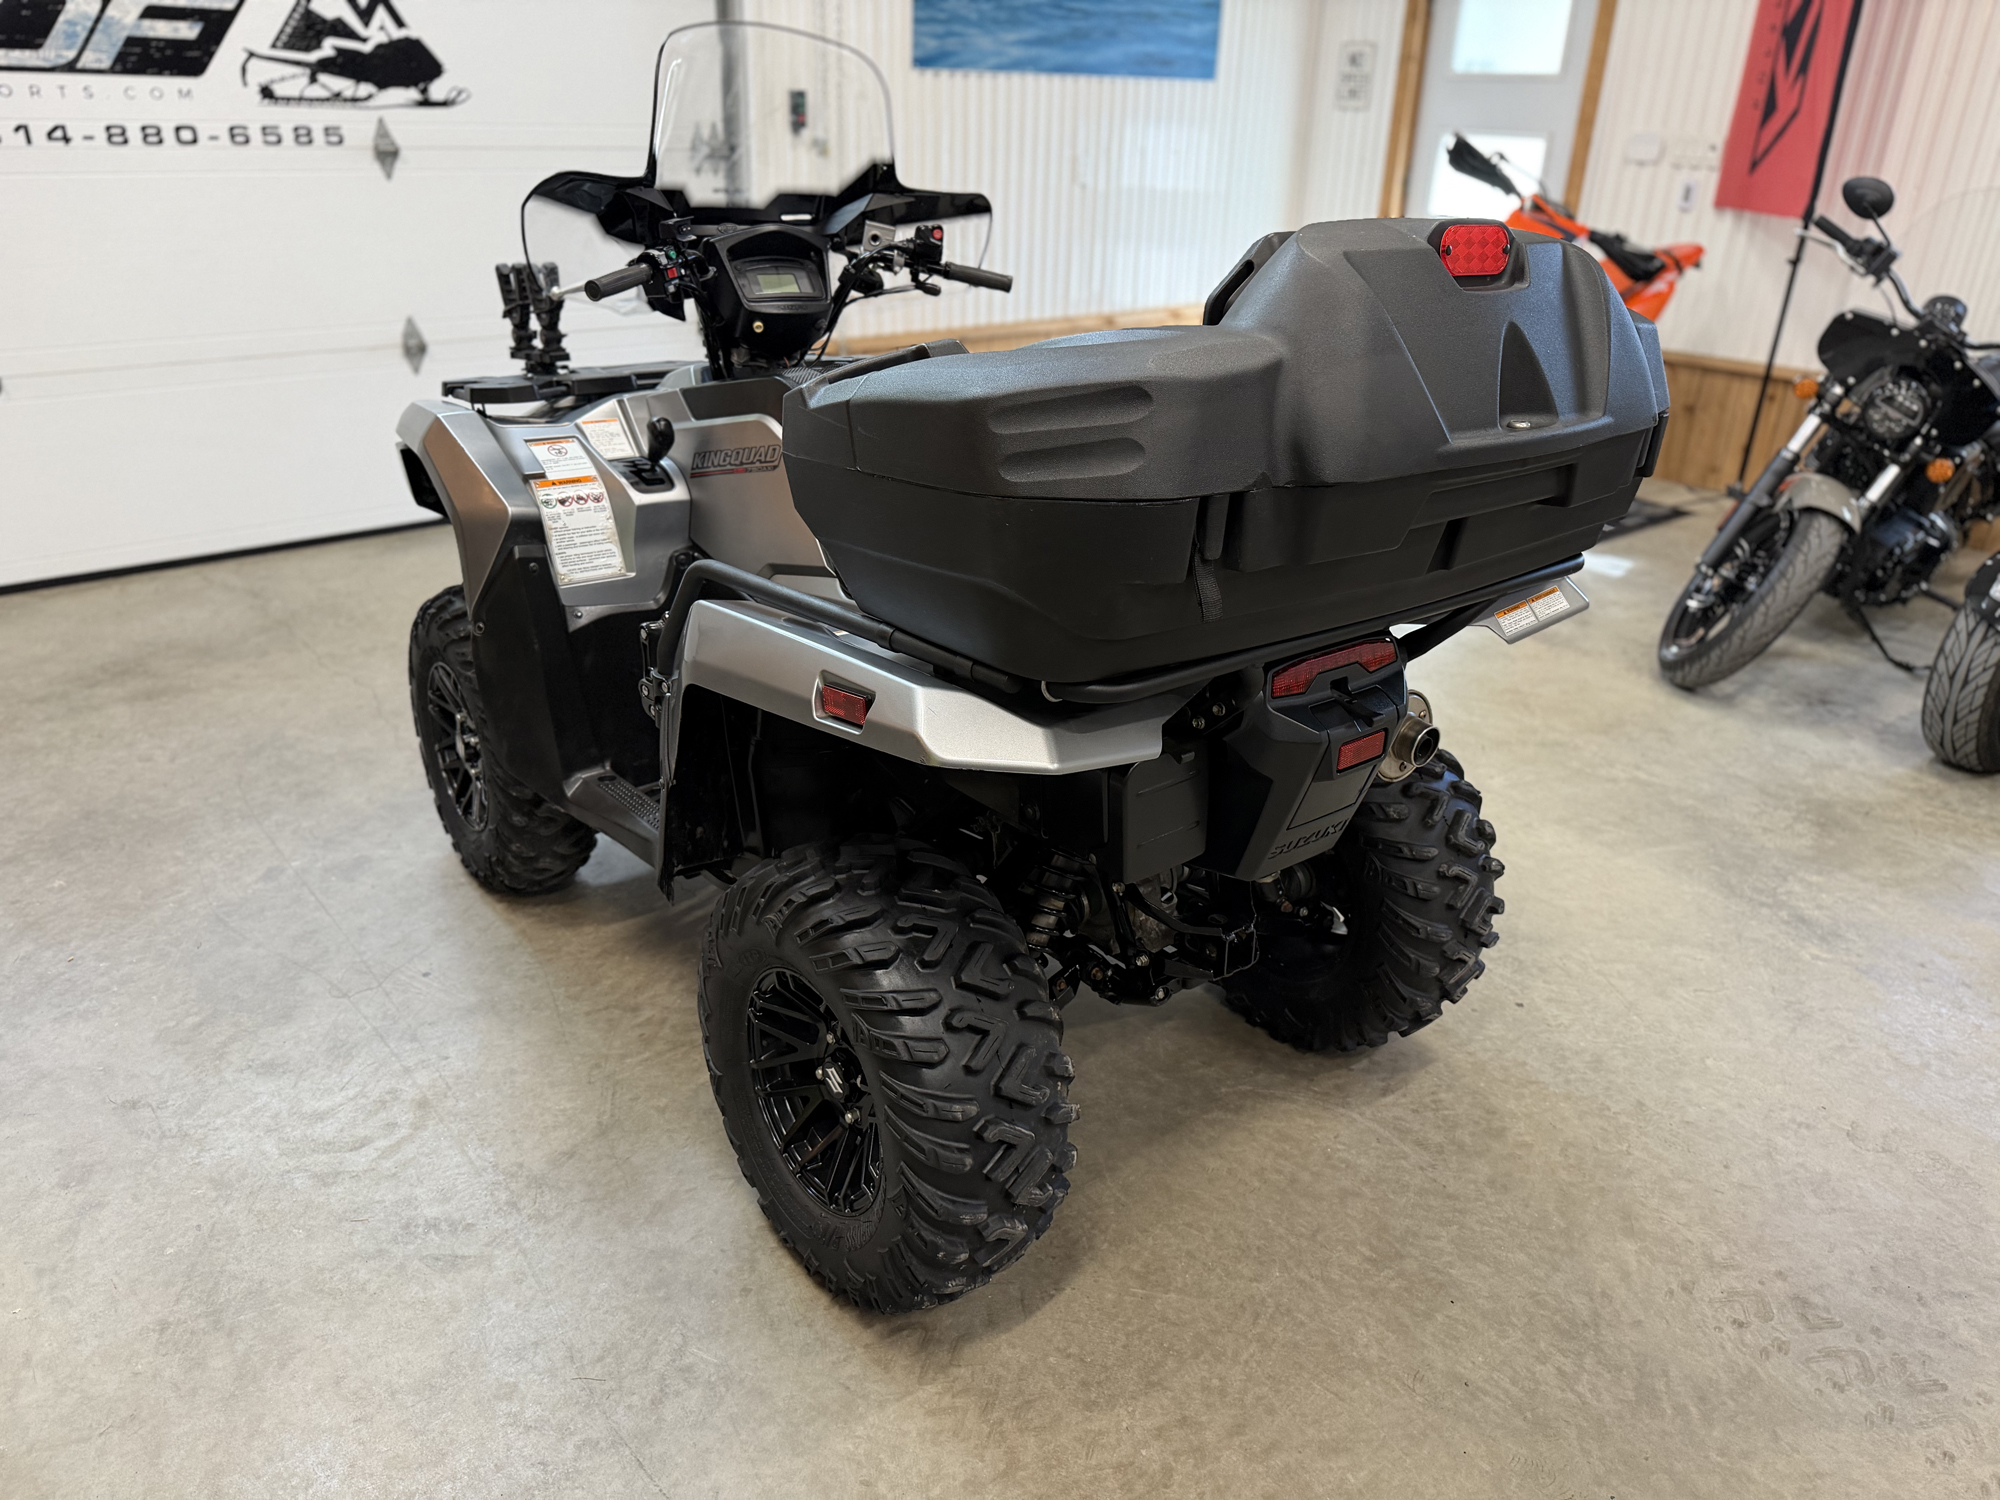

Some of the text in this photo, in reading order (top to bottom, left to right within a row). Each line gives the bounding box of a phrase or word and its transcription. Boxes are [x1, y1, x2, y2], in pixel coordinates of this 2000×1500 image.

[0, 124, 345, 147] 14-880-6585
[691, 444, 781, 470] KINGQUAD
[558, 478, 582, 486] WARNING
[1267, 818, 1350, 860] SUZUKI
